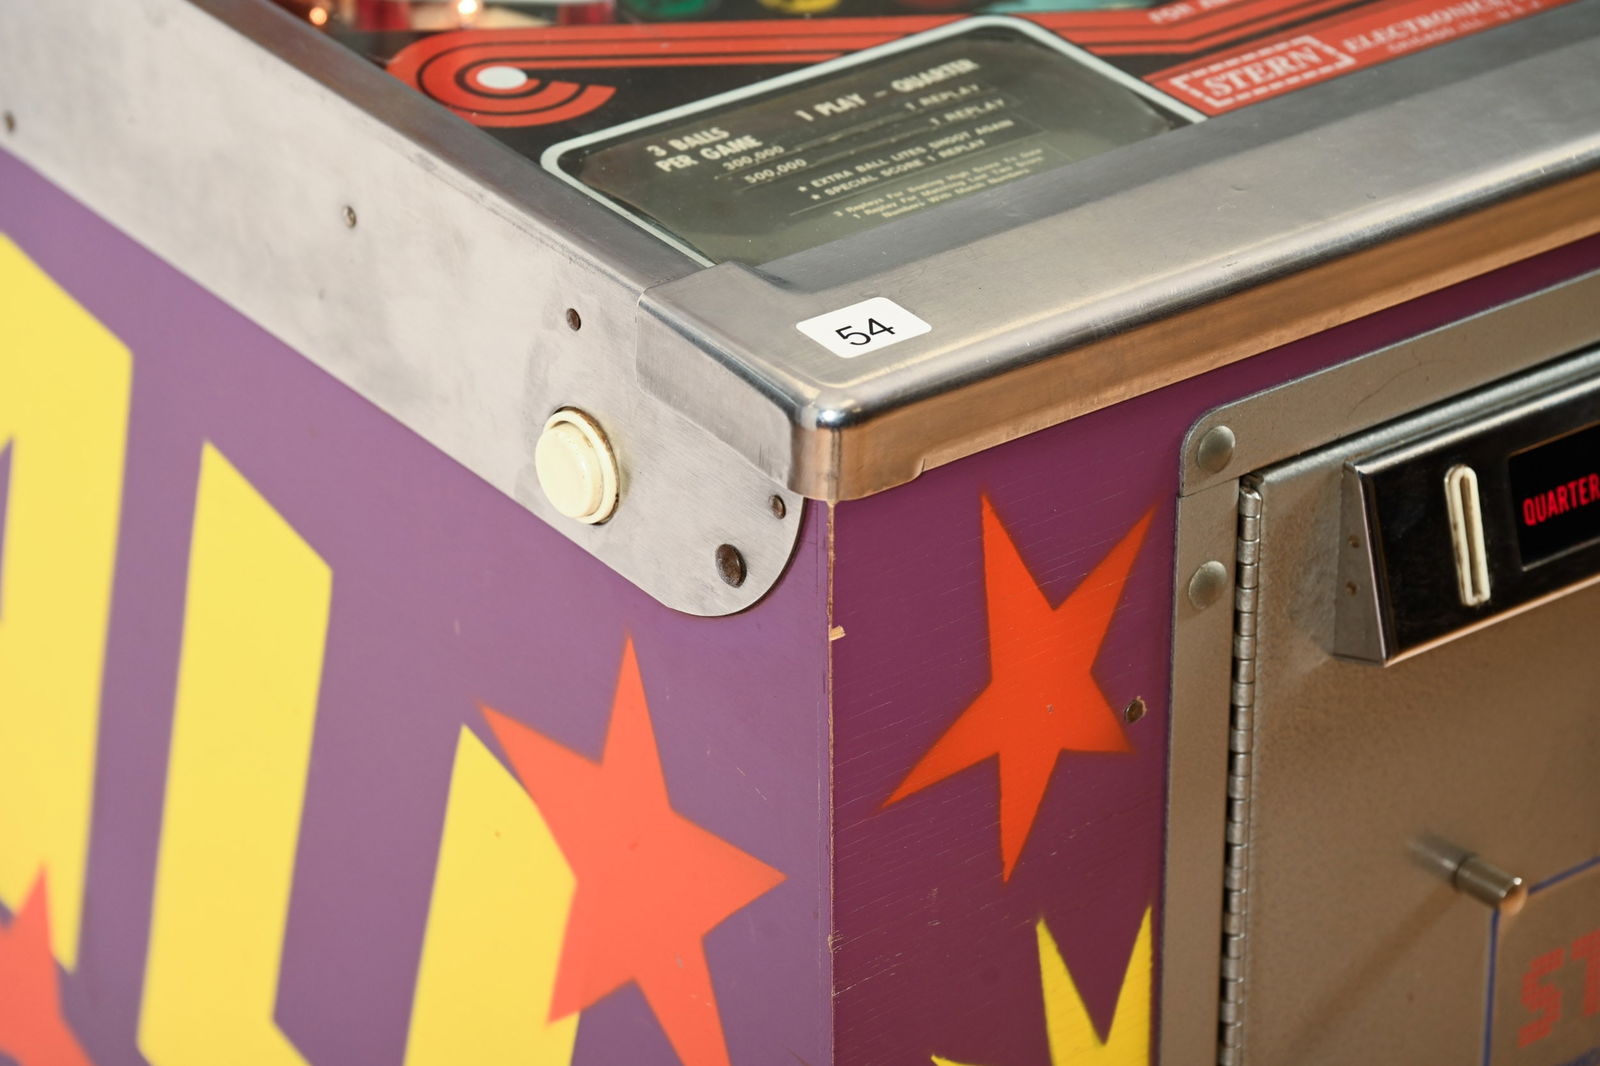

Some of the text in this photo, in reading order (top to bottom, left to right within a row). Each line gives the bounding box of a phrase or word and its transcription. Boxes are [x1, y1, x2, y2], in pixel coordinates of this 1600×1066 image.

[796, 107, 813, 122] 1
[814, 92, 867, 118] PLAY
[891, 58, 980, 92] QUARTER
[1202, 45, 1323, 99] STERN
[943, 98, 1006, 122] REPLAY
[646, 126, 730, 157] 3 BALLS
[656, 133, 764, 173] PER GAME
[811, 170, 853, 188] EXTRA
[857, 158, 890, 173] BALL
[893, 146, 927, 161] LITES
[824, 175, 878, 196] SPECIAL
[881, 159, 925, 177] SCORE
[938, 139, 985, 159] REPLAY
[835, 317, 896, 346] 54
